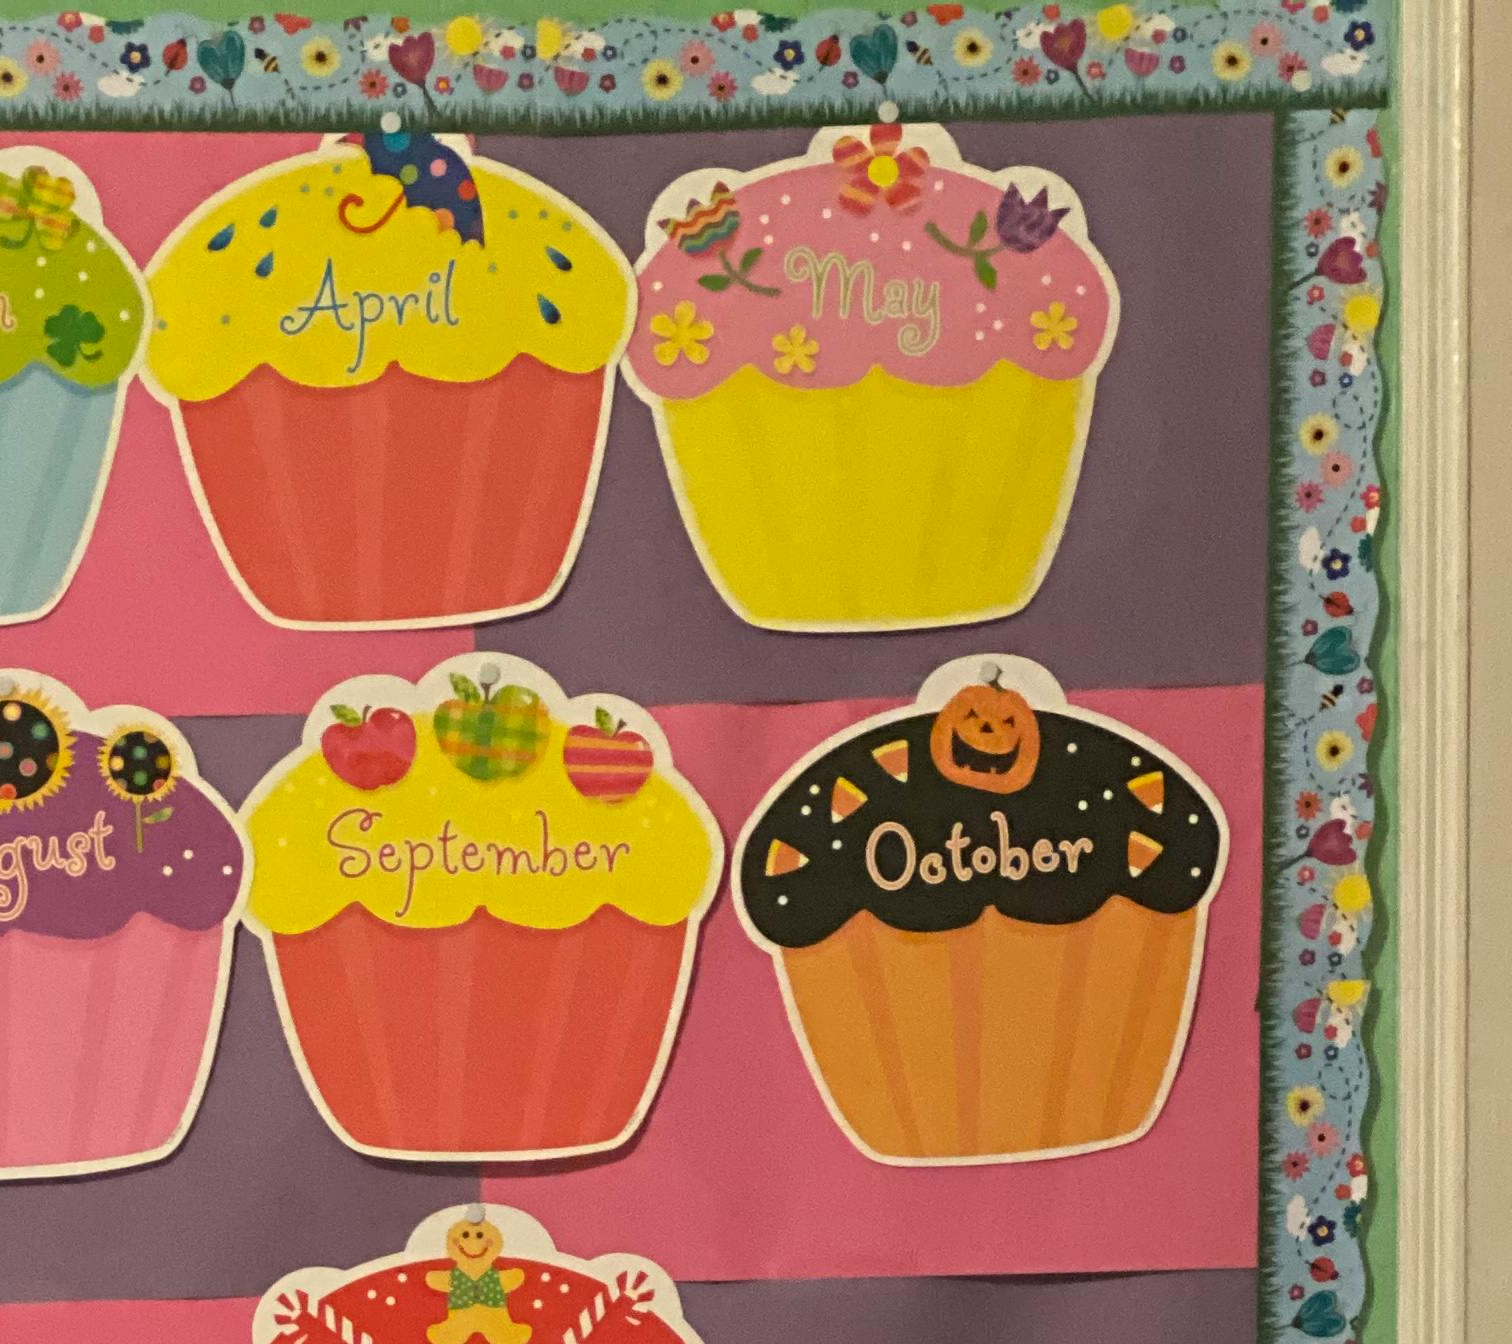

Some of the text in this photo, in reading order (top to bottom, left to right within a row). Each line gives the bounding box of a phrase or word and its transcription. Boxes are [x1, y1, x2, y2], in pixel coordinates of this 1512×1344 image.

[279, 257, 459, 375] April
[784, 246, 940, 357] May
[327, 808, 630, 918] September
[865, 811, 1093, 891] October
